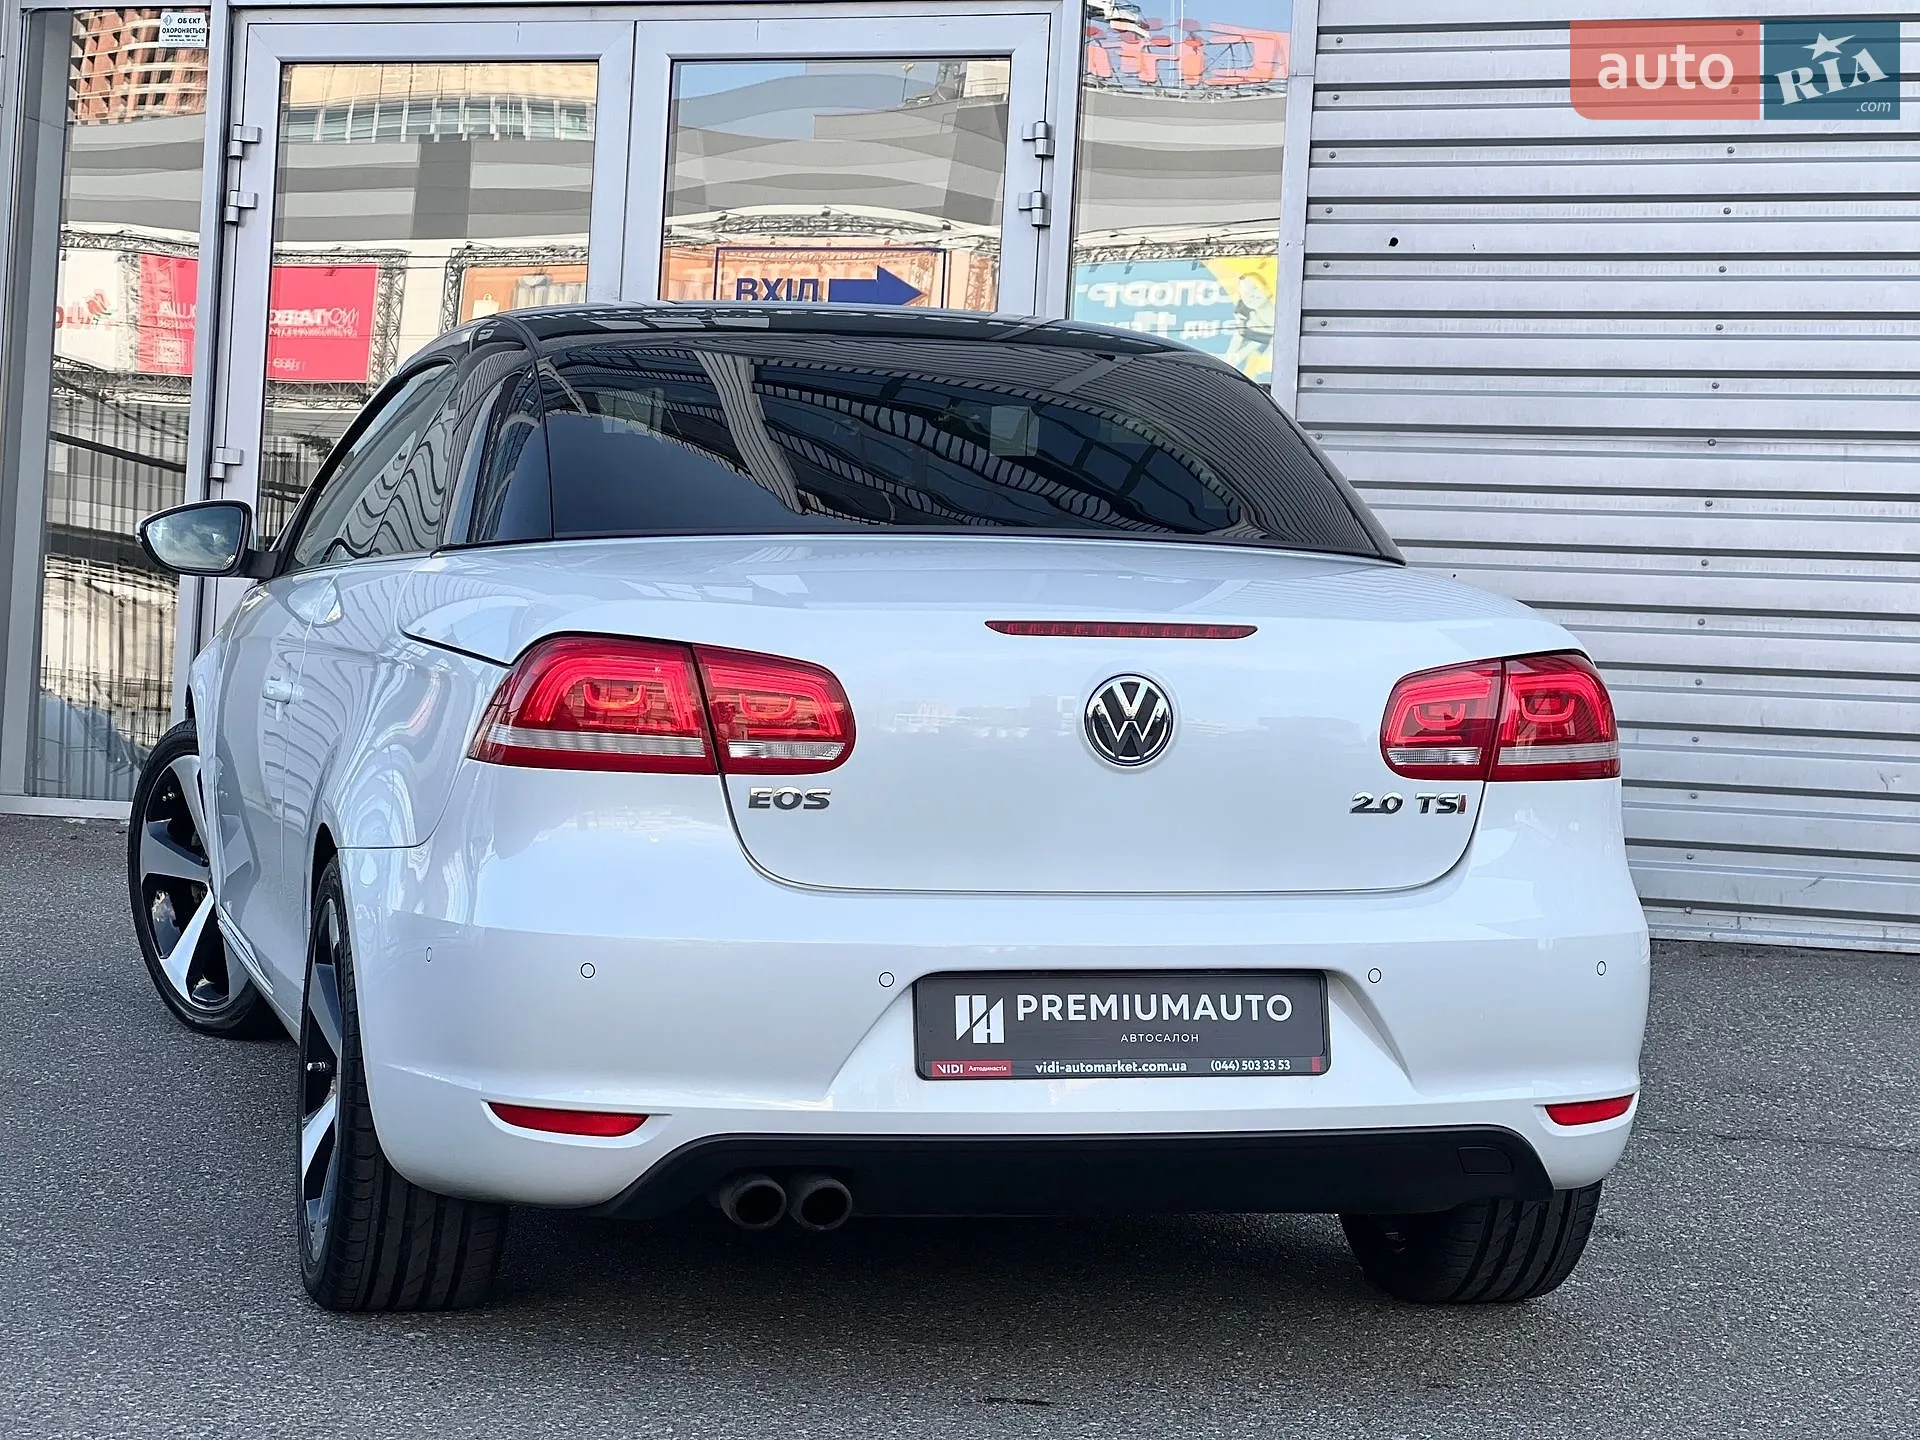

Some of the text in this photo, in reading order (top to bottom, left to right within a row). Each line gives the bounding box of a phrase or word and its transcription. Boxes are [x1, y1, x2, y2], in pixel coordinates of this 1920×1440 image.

[748, 786, 832, 810] EOS
[1415, 791, 1467, 814] TSI
[1016, 993, 1293, 1022] PREMIUMAUTO
[1120, 1033, 1200, 1043] АВТОСАЛОН
[936, 1063, 964, 1074] VIDI
[1034, 1059, 1187, 1074] vidi-automarket.com.ua
[1210, 1059, 1291, 1072] (044) 503 33 53
